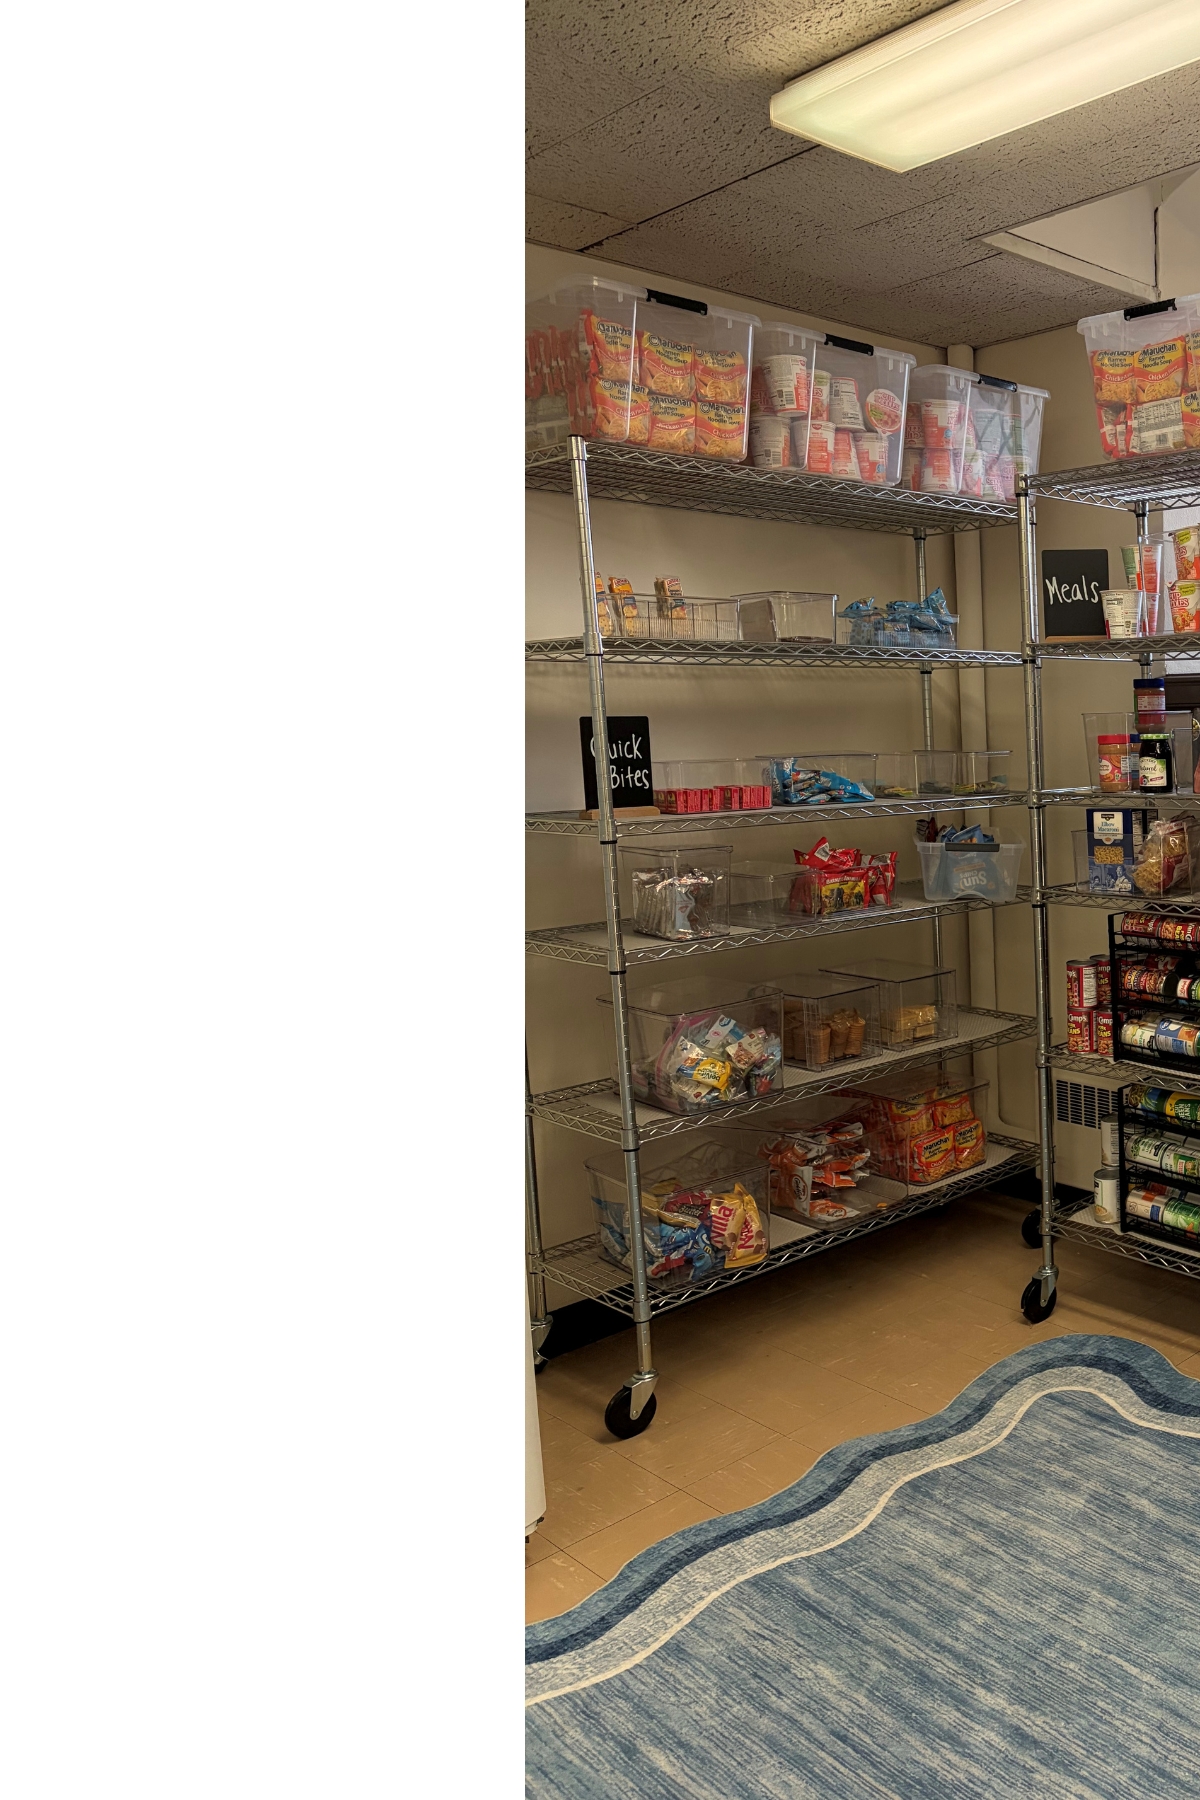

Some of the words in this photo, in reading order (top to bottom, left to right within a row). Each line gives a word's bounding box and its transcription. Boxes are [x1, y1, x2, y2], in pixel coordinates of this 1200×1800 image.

[1142, 342, 1177, 357] Maruchan
[1142, 360, 1161, 369] Noodle
[1160, 358, 1173, 366] Soup
[1148, 354, 1166, 362] Ramen
[1148, 370, 1168, 380] Chicken
[1045, 575, 1099, 605] Meals
[590, 734, 642, 759] uick
[610, 765, 650, 790] Bites
[923, 1137, 950, 1151] Maruchan
